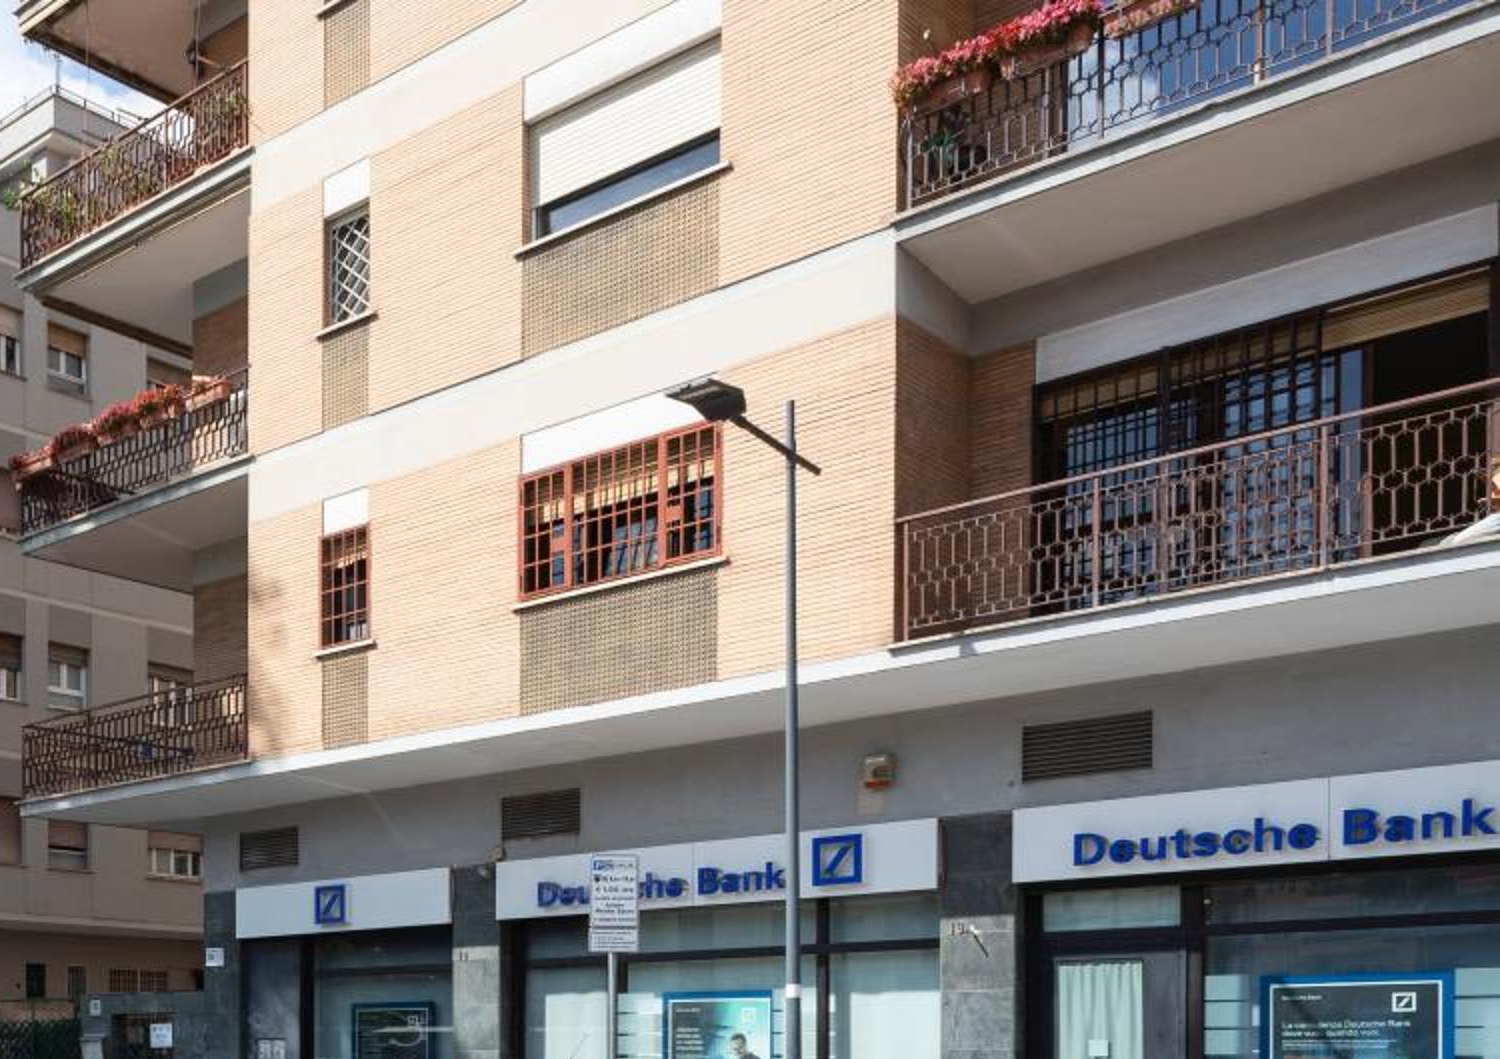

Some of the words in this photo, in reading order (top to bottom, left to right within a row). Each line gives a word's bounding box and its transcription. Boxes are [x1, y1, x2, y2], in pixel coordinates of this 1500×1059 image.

[1072, 816, 1320, 867] Deutsche
[1343, 797, 1500, 846] Bank
[537, 872, 685, 908] Deuhe
[697, 861, 787, 896] Bank
